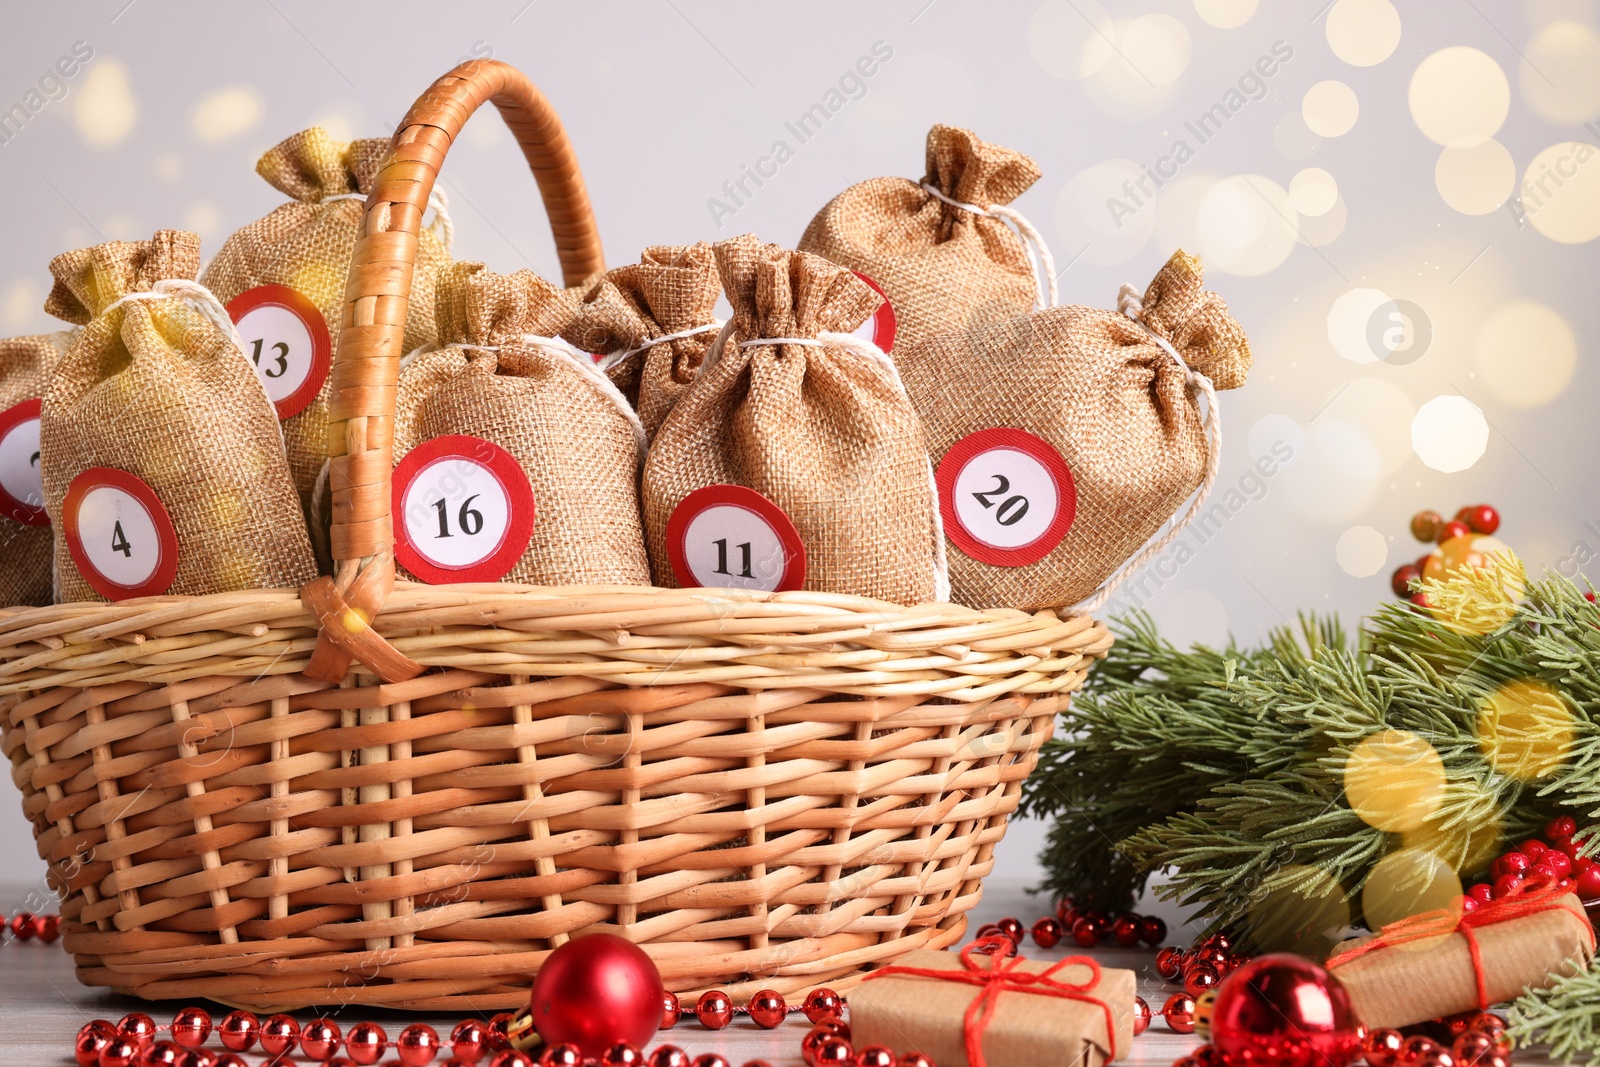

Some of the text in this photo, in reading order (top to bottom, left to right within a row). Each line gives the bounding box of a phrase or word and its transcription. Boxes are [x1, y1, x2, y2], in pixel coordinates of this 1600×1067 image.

[250, 338, 290, 378] 13
[431, 494, 484, 539] 16
[971, 474, 1030, 526] 20
[111, 520, 132, 558] 4
[712, 538, 757, 580] 11
